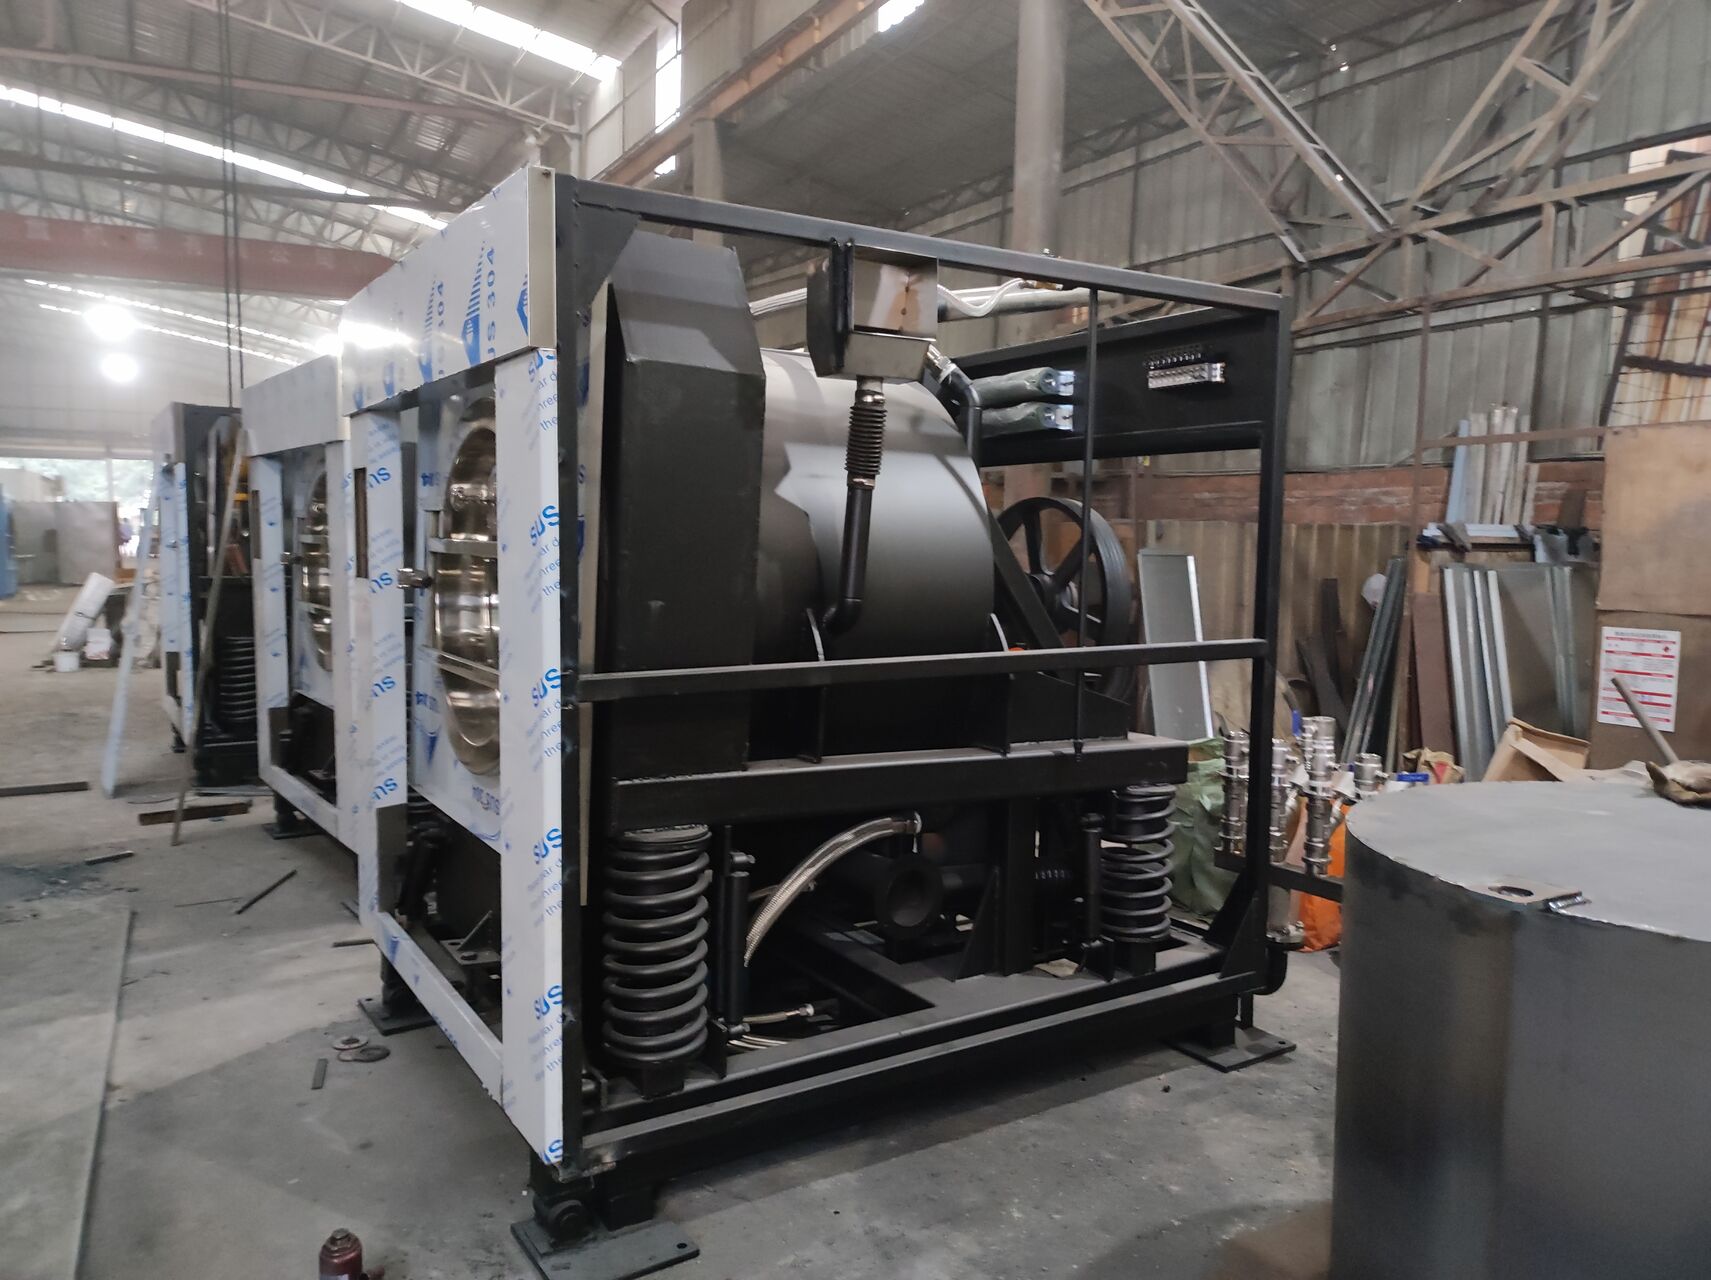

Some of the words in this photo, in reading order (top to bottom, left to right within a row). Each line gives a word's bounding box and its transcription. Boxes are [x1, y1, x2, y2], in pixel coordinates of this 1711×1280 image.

[486, 247, 497, 310] 304
[529, 505, 560, 547] SUS
[531, 667, 561, 708] SUS
[534, 828, 562, 866] SUS
[534, 985, 562, 1021] SUS
